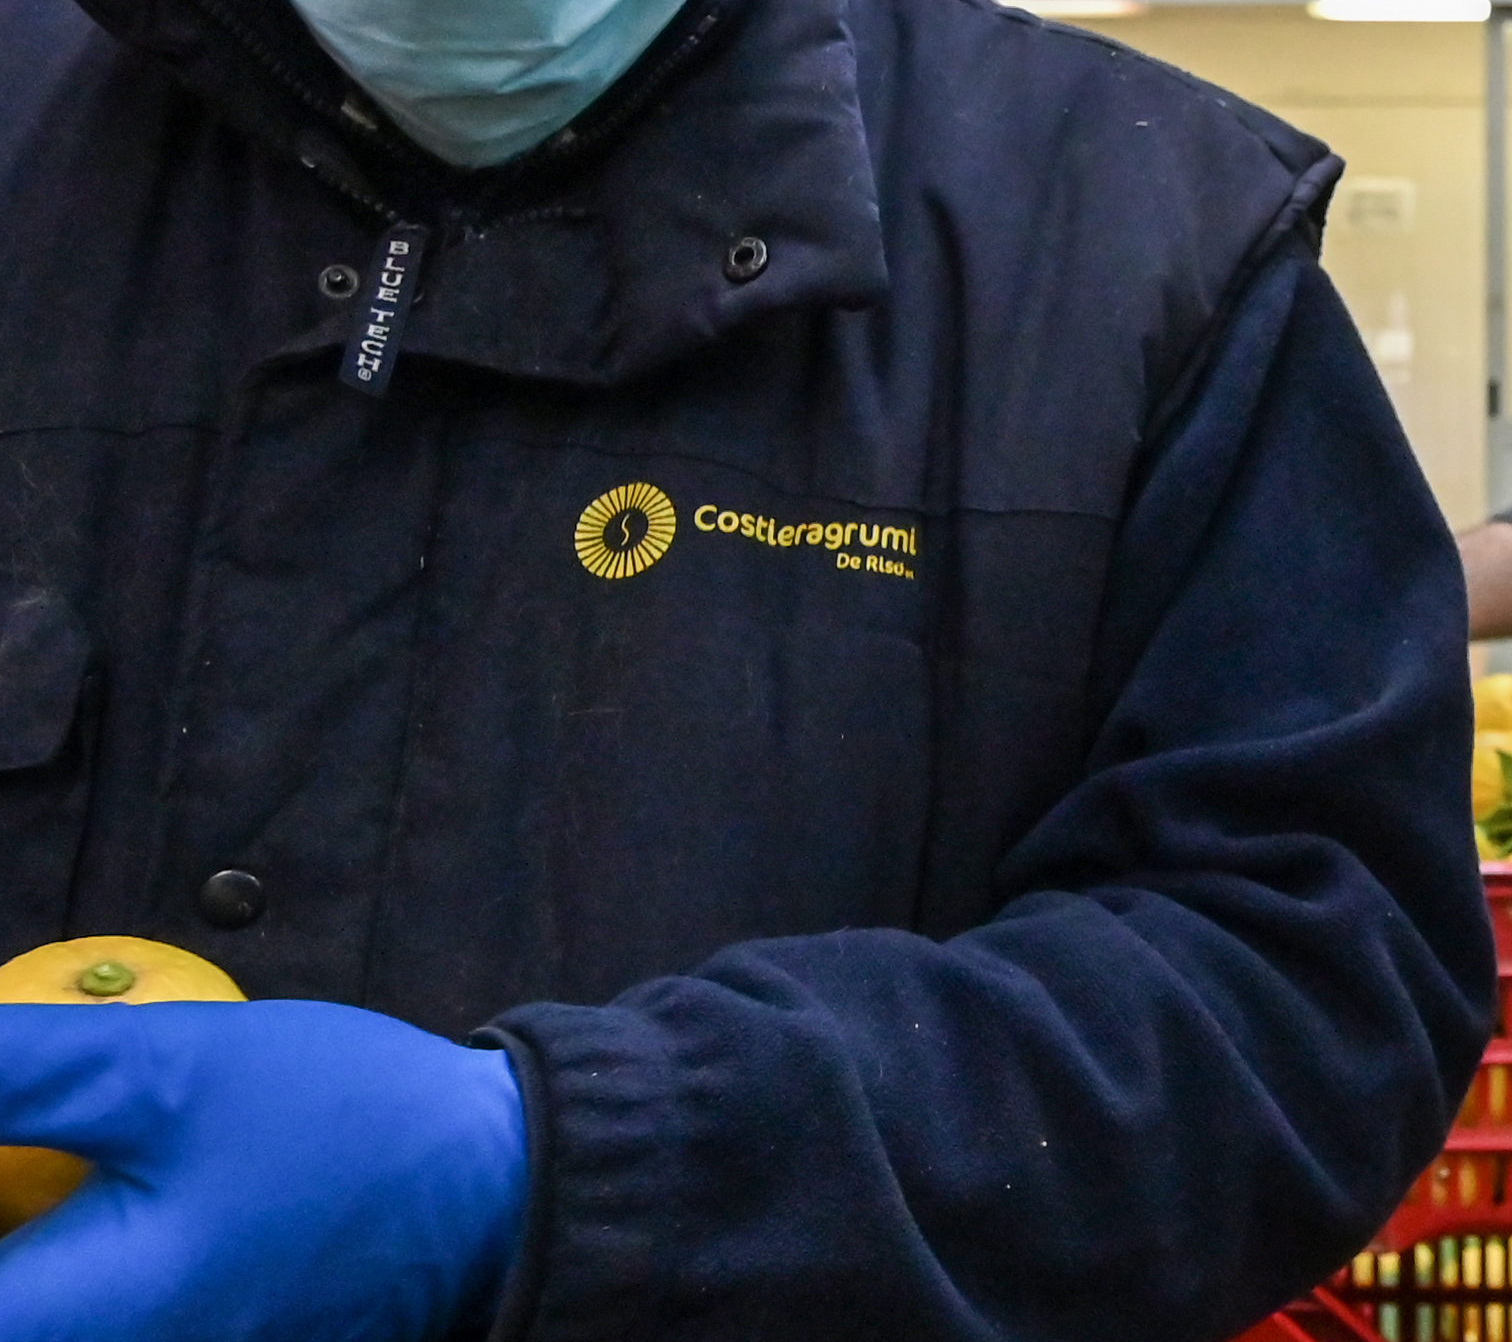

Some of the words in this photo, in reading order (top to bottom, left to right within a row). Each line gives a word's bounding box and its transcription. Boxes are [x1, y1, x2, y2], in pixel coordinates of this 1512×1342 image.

[377, 240, 410, 302] BLUE
[693, 504, 917, 556] Costieragrumi
[836, 552, 862, 570] De
